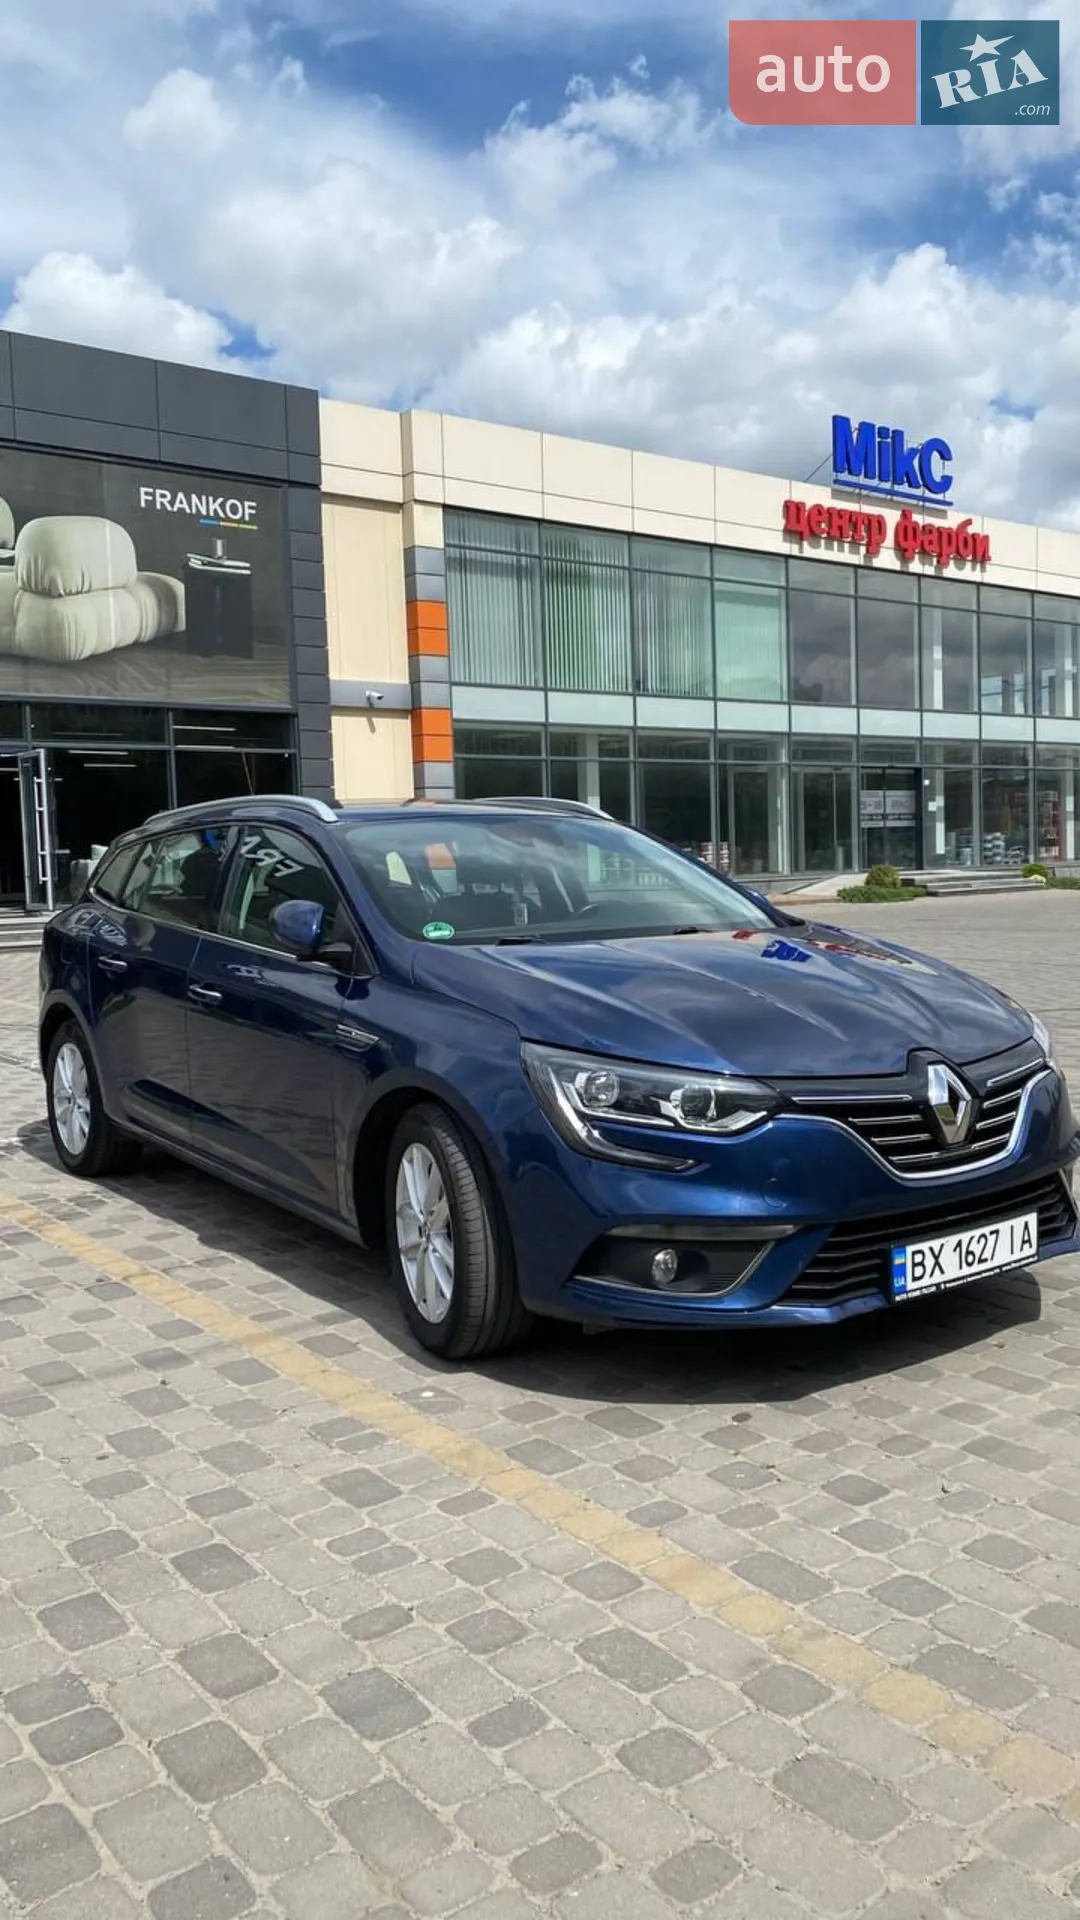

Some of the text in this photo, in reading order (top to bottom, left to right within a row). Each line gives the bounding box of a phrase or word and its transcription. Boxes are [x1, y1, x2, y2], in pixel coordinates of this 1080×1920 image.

[139, 486, 257, 522] FRANKOF
[783, 499, 992, 569] центр фарби
[911, 1242, 945, 1283] BX
[953, 1228, 1000, 1271] 1627
[893, 1277, 906, 1288] UA
